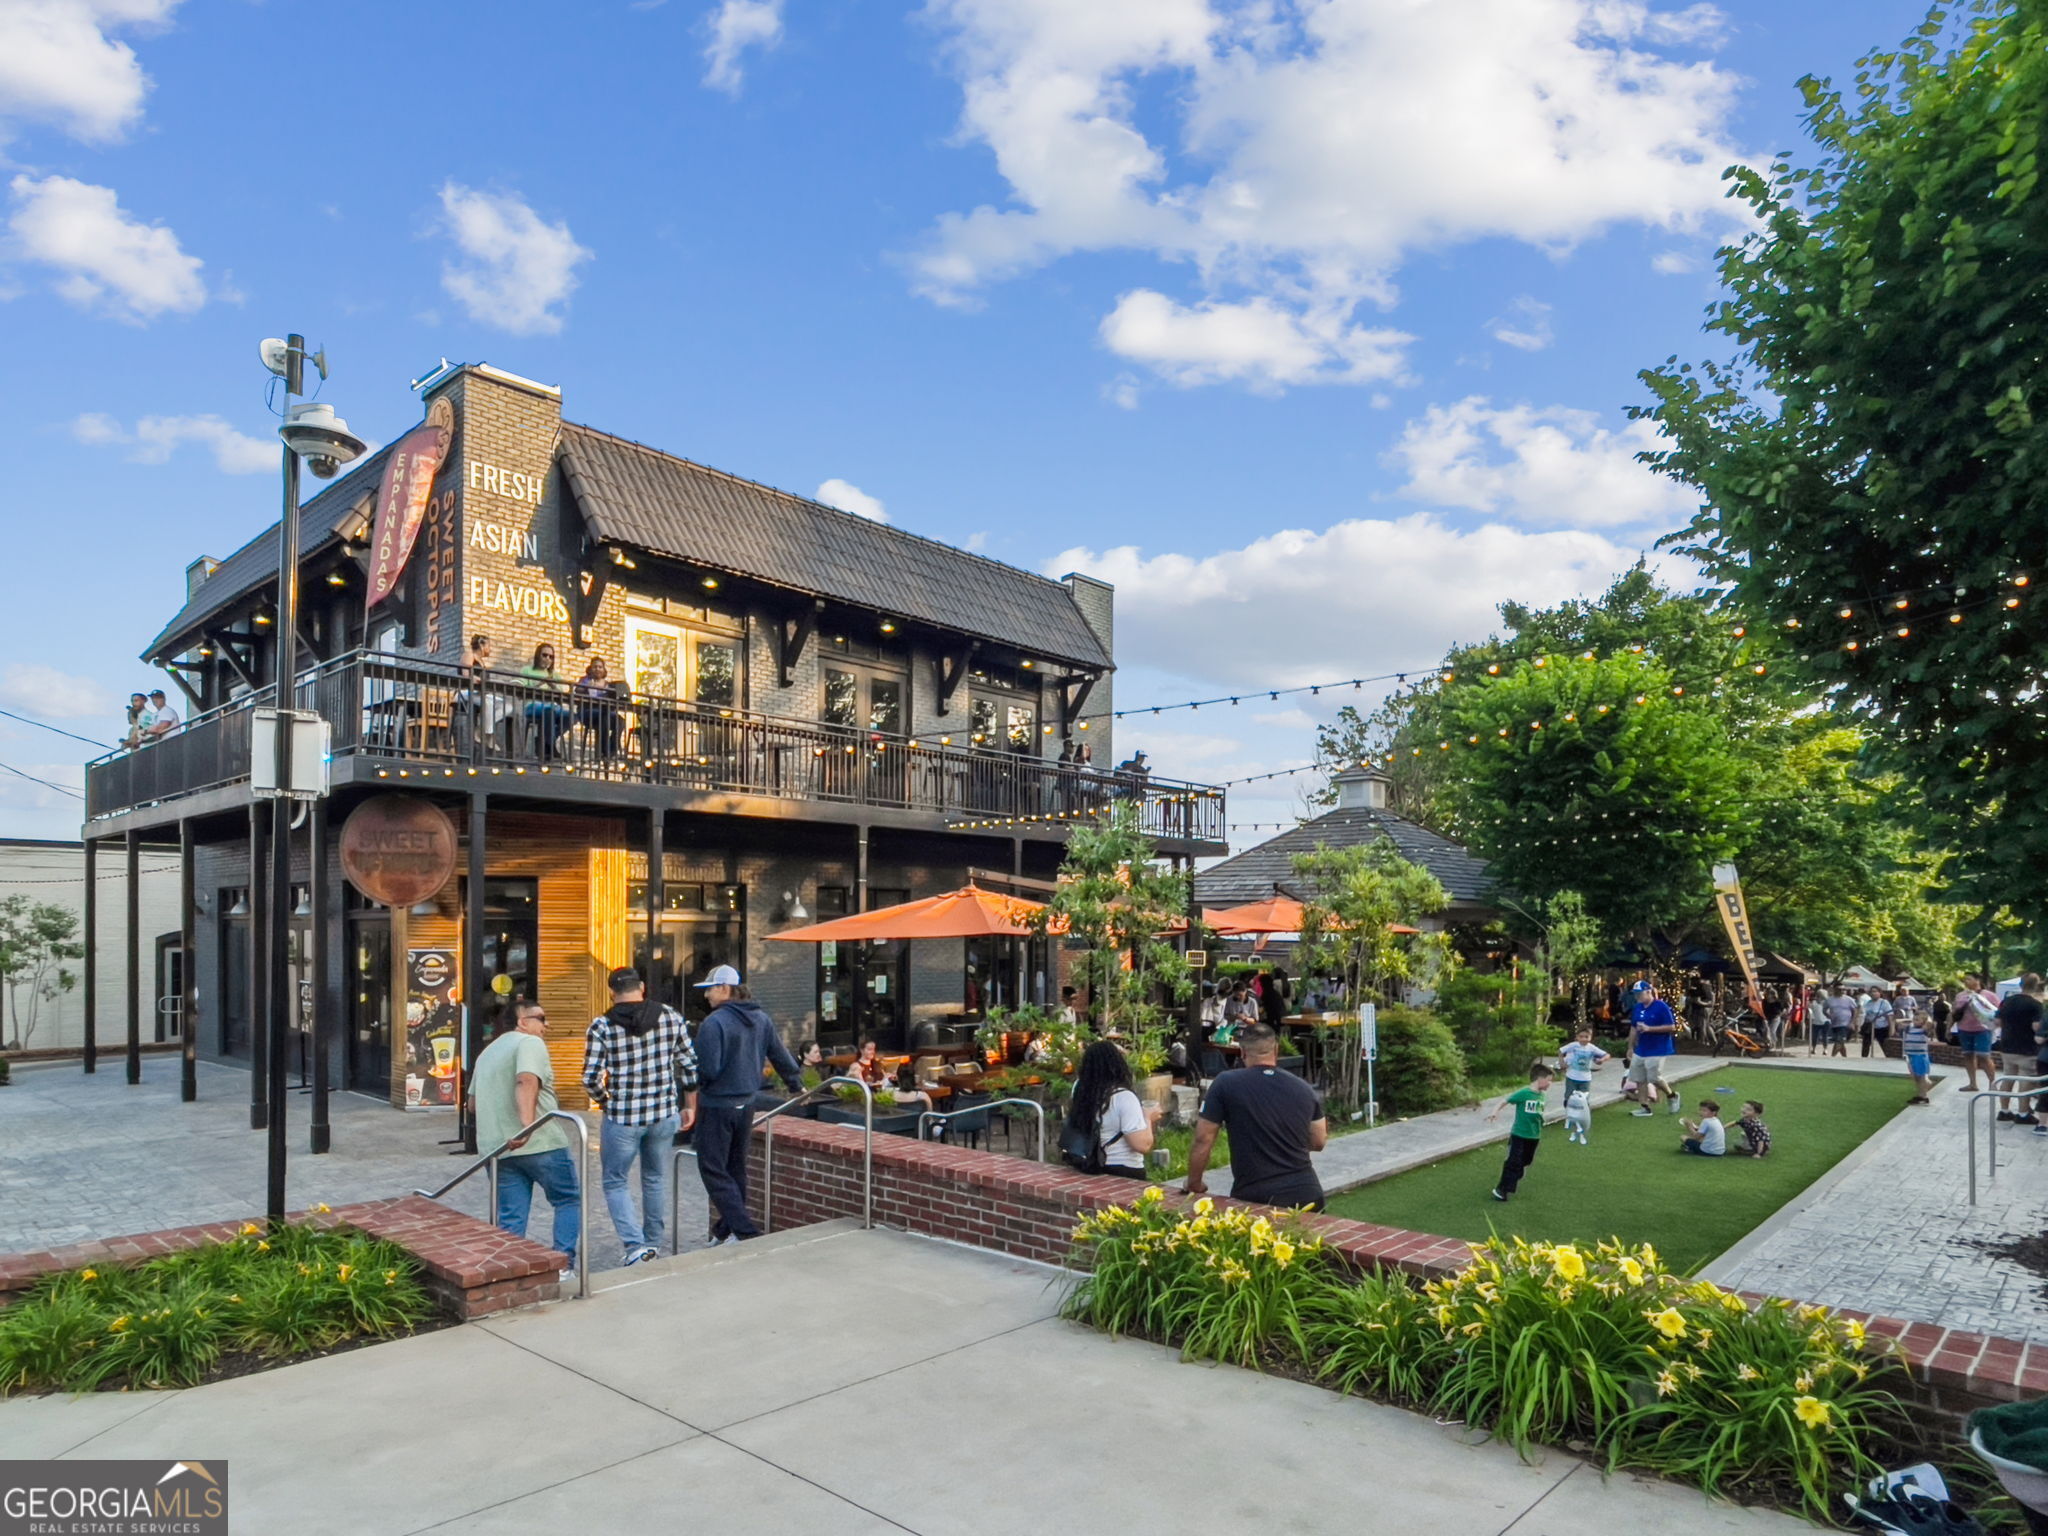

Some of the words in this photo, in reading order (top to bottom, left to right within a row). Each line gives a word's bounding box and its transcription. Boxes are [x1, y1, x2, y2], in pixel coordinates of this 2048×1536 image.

[470, 461, 543, 505] FRESH
[376, 453, 406, 592] EMPANADAS
[470, 520, 538, 561] ASIAN
[442, 489, 456, 603] SWEET
[426, 496, 441, 655] OCTOPUS
[470, 576, 570, 622] FLAVORS
[357, 830, 439, 850] SWEET
